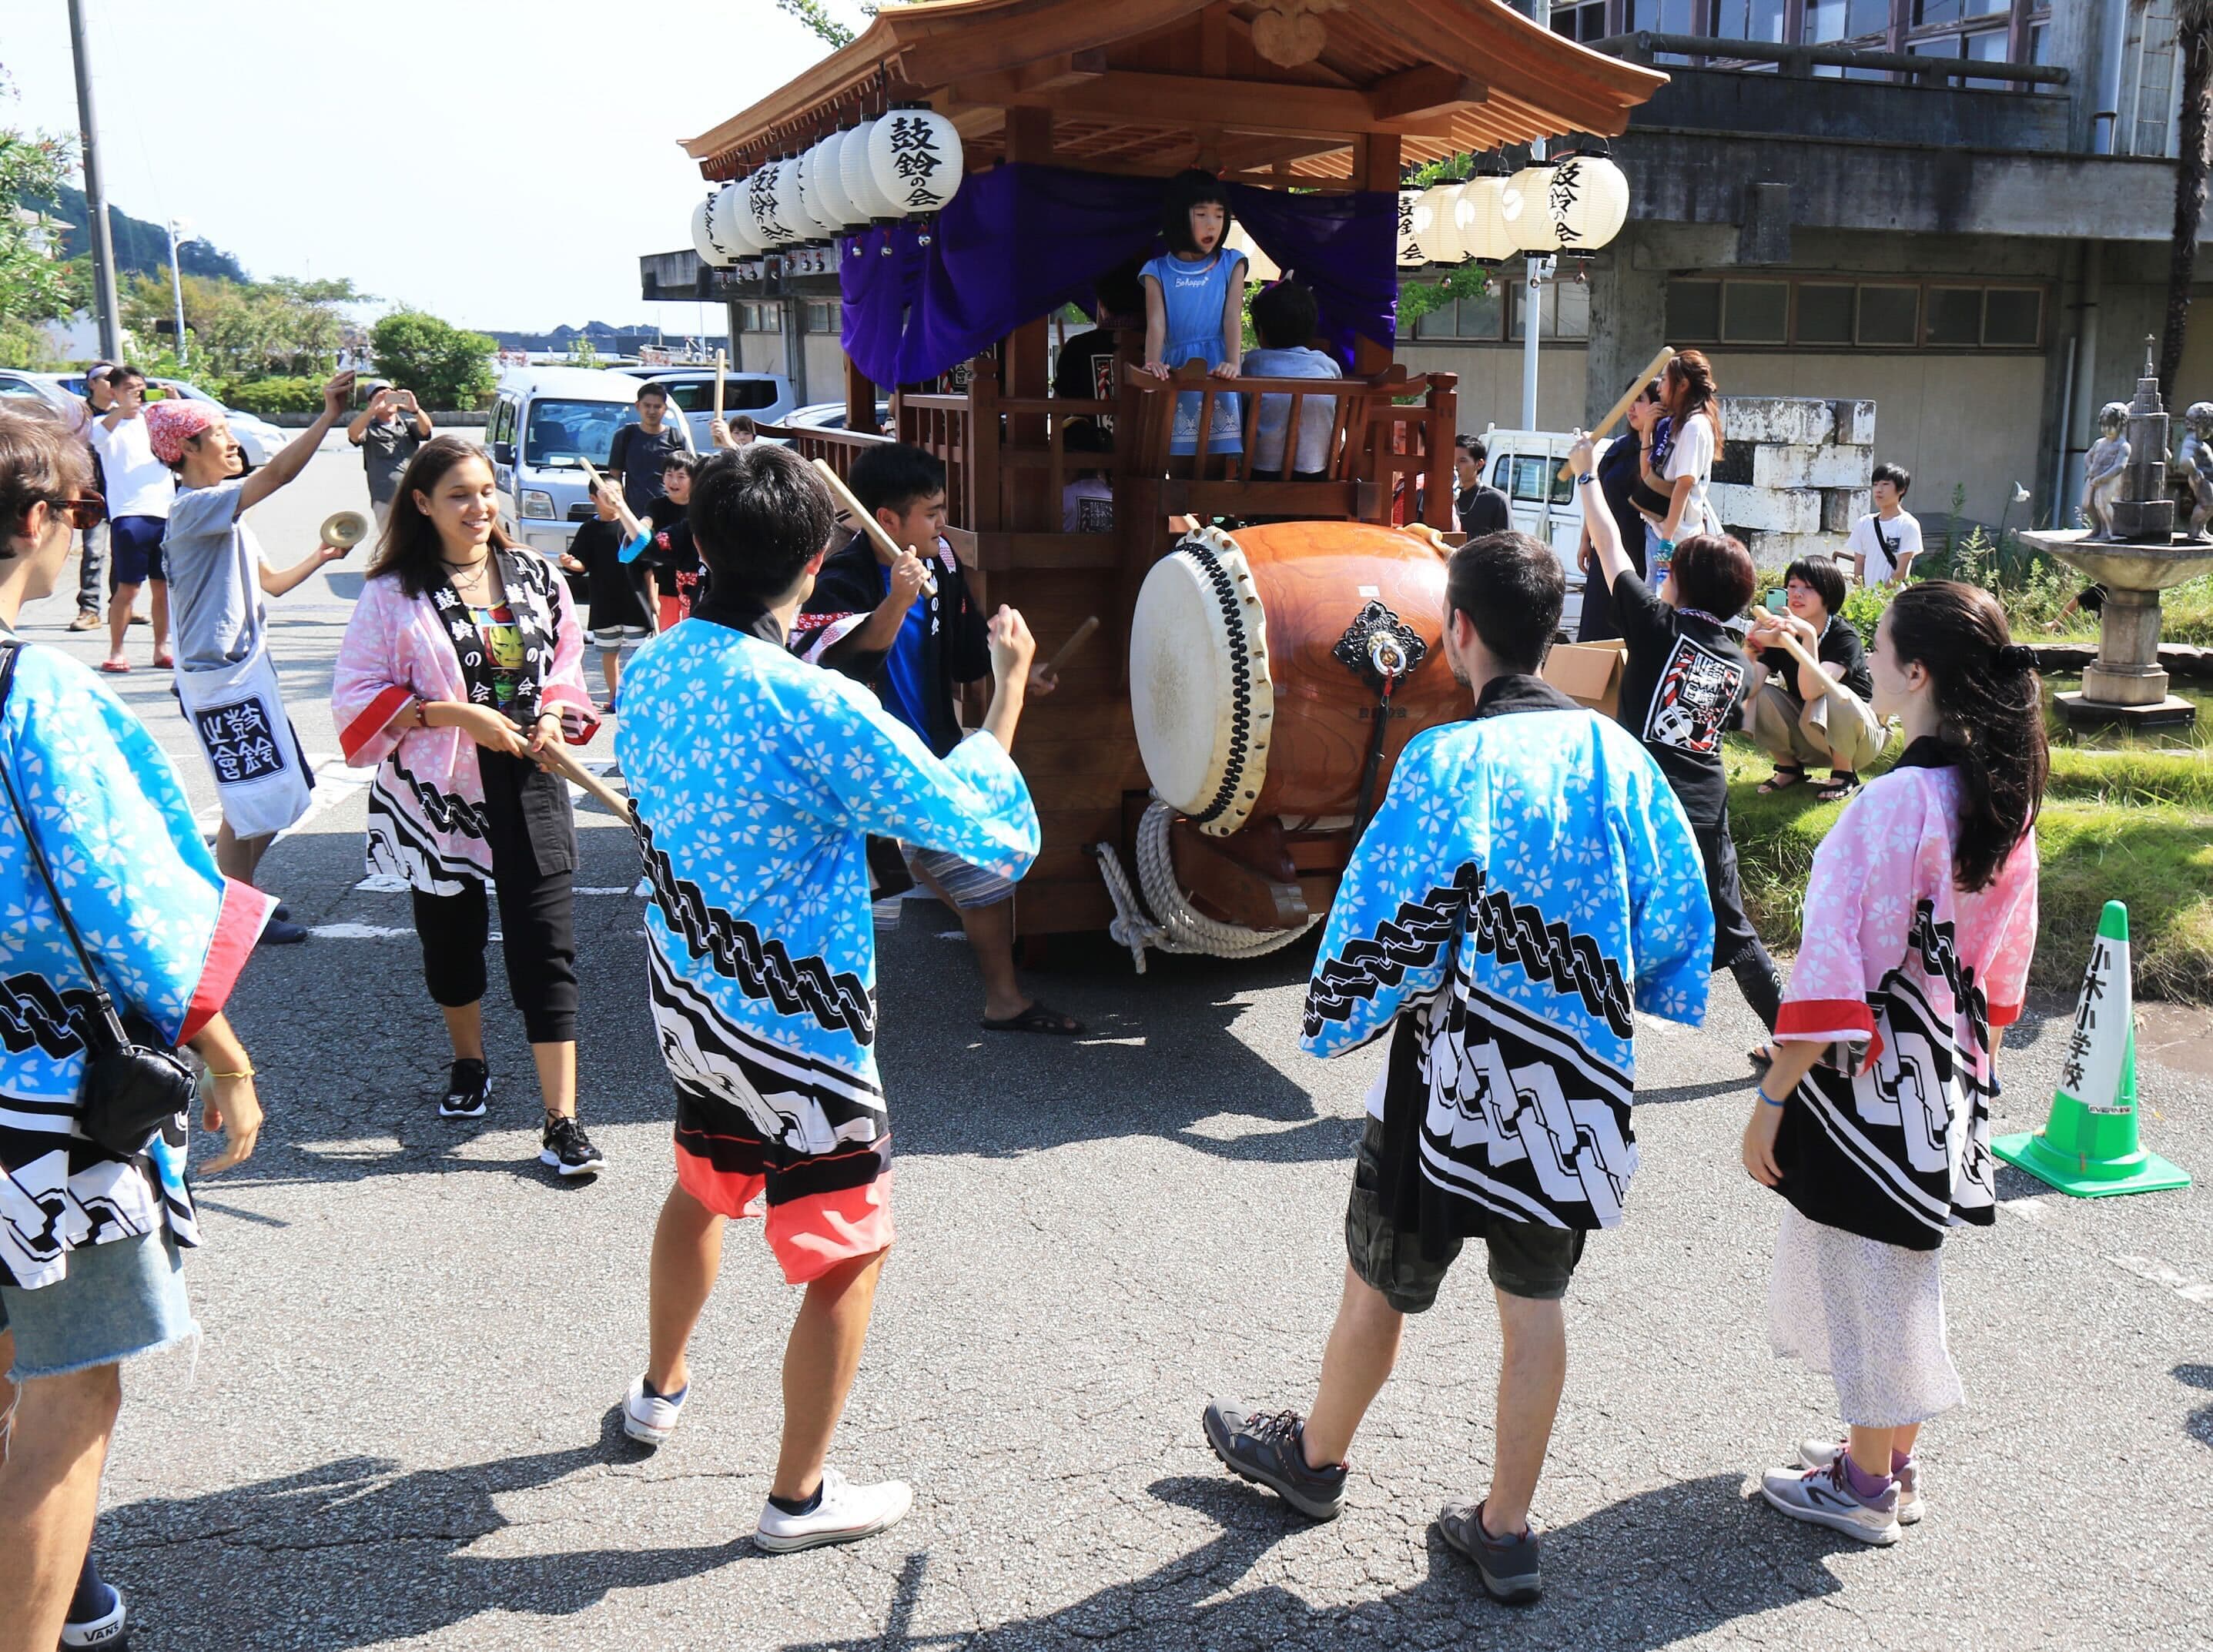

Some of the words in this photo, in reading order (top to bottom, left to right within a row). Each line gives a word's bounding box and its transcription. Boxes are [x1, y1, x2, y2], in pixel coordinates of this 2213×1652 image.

[890, 117, 944, 207] 鼓鈴の会
[1550, 162, 1583, 242] 鼓鈴の会
[434, 587, 492, 703] 鼓鈴の会
[2060, 943, 2111, 1092] 小木小学校
[84, 1620, 119, 1642] VANS
